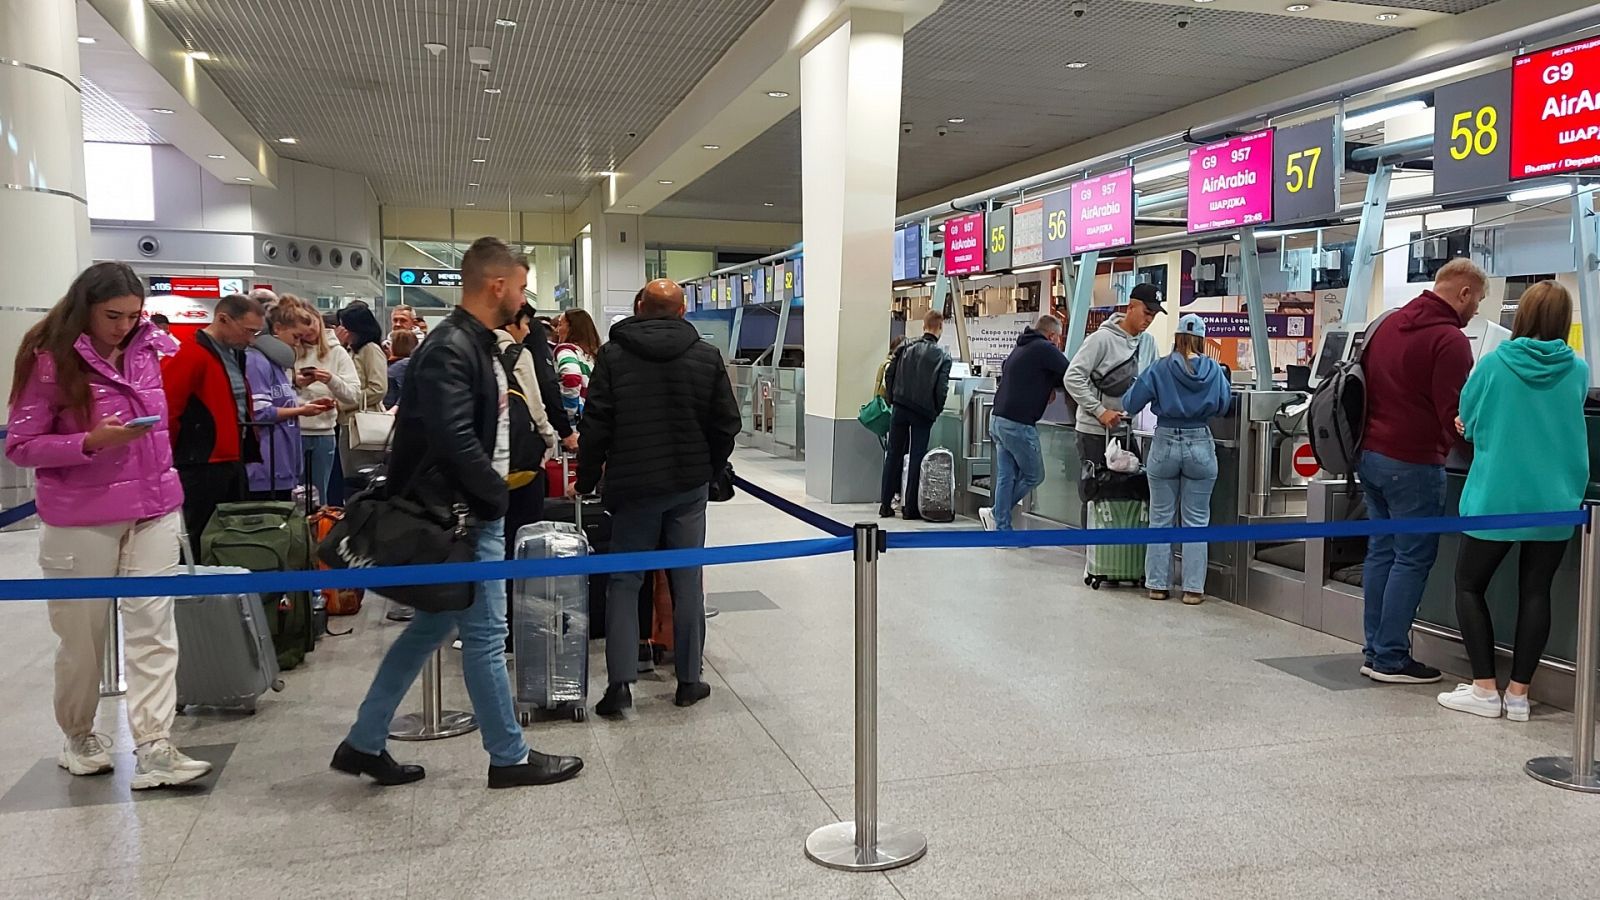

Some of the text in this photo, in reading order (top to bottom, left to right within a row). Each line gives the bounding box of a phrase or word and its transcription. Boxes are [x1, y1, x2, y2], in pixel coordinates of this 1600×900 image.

[1542, 62, 1574, 85] G9
[1450, 106, 1498, 160] 58
[1202, 147, 1252, 169] G9 957
[1286, 147, 1322, 193] 57
[1081, 182, 1117, 201] G9 957
[1202, 170, 1256, 194] AirArabia
[1081, 201, 1120, 221] AirArabia
[1209, 196, 1246, 211] ШАРДЖА
[964, 222, 974, 233] 957
[1048, 210, 1067, 241] 56
[951, 237, 977, 251] AirArabia
[991, 226, 1006, 254] 55
[785, 271, 793, 290] 52
[980, 328, 1001, 336] Скоро
